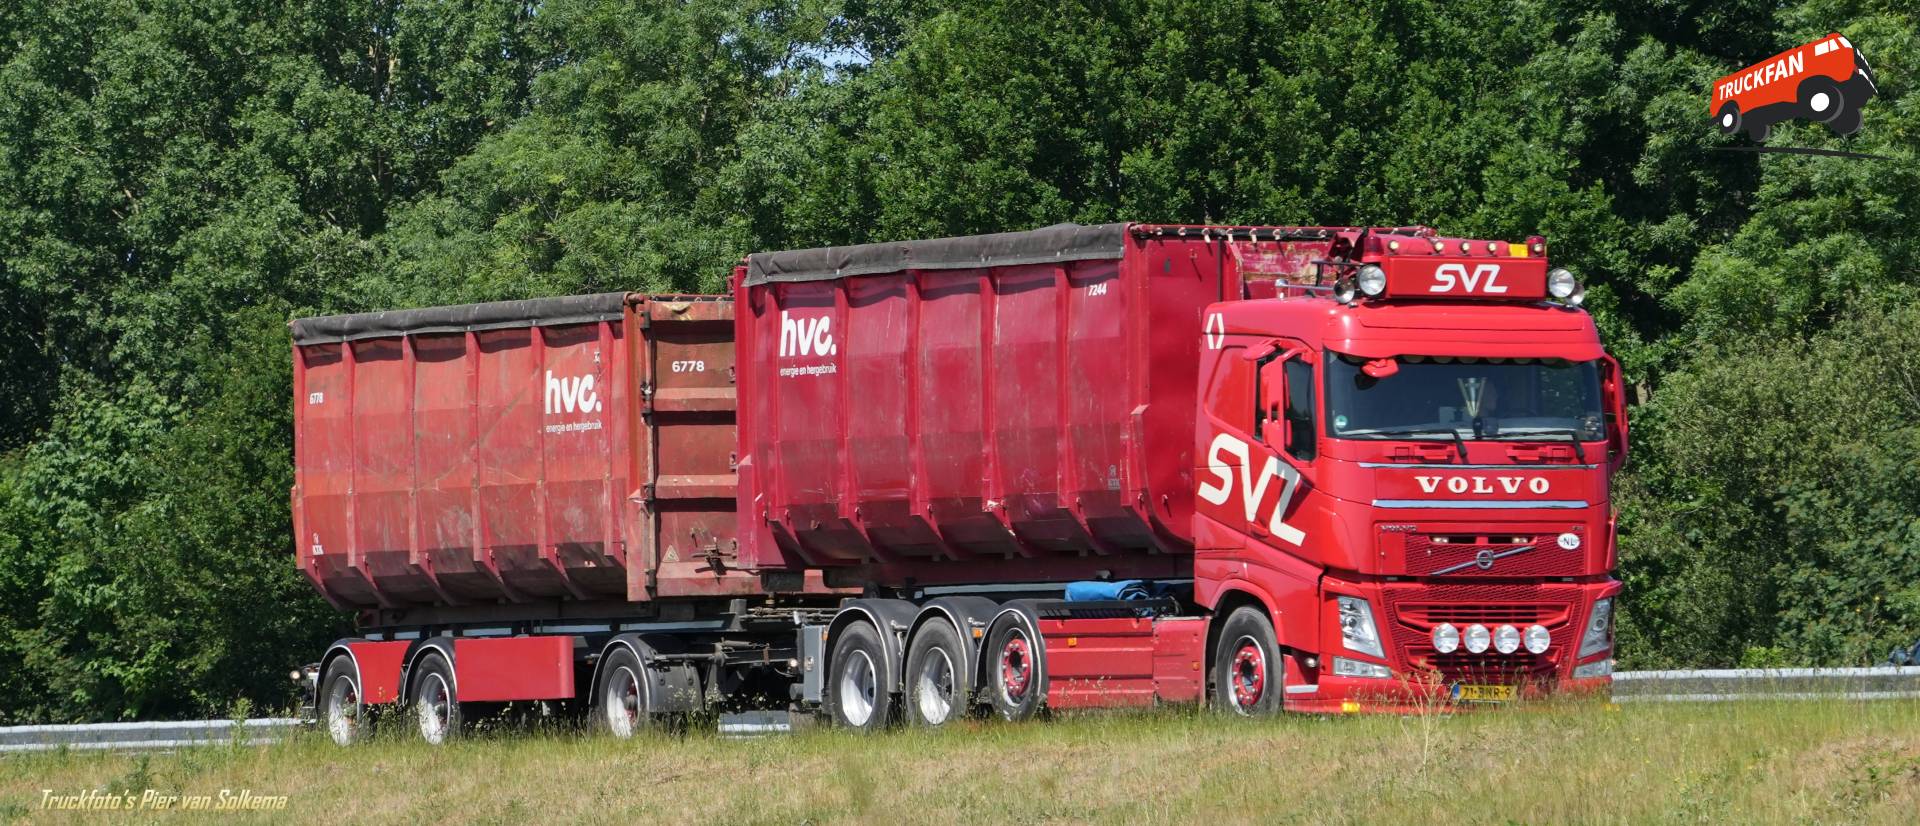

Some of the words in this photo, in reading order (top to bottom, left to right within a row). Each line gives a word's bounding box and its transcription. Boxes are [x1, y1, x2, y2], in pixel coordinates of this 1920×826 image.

[1429, 263, 1509, 293] SVZ
[1088, 282, 1108, 297] 7244
[779, 310, 837, 357] hvc.
[671, 360, 705, 373] 6778
[780, 365, 799, 378] energie
[799, 367, 806, 375] en
[806, 363, 837, 376] hergebruik
[545, 370, 602, 415] hvc.
[545, 422, 566, 434] energie
[566, 423, 573, 432] en
[573, 420, 602, 433] hergebruik
[1198, 432, 1306, 547] SVZ
[1414, 476, 1550, 495] VOLVO
[1563, 537, 1576, 547] NL
